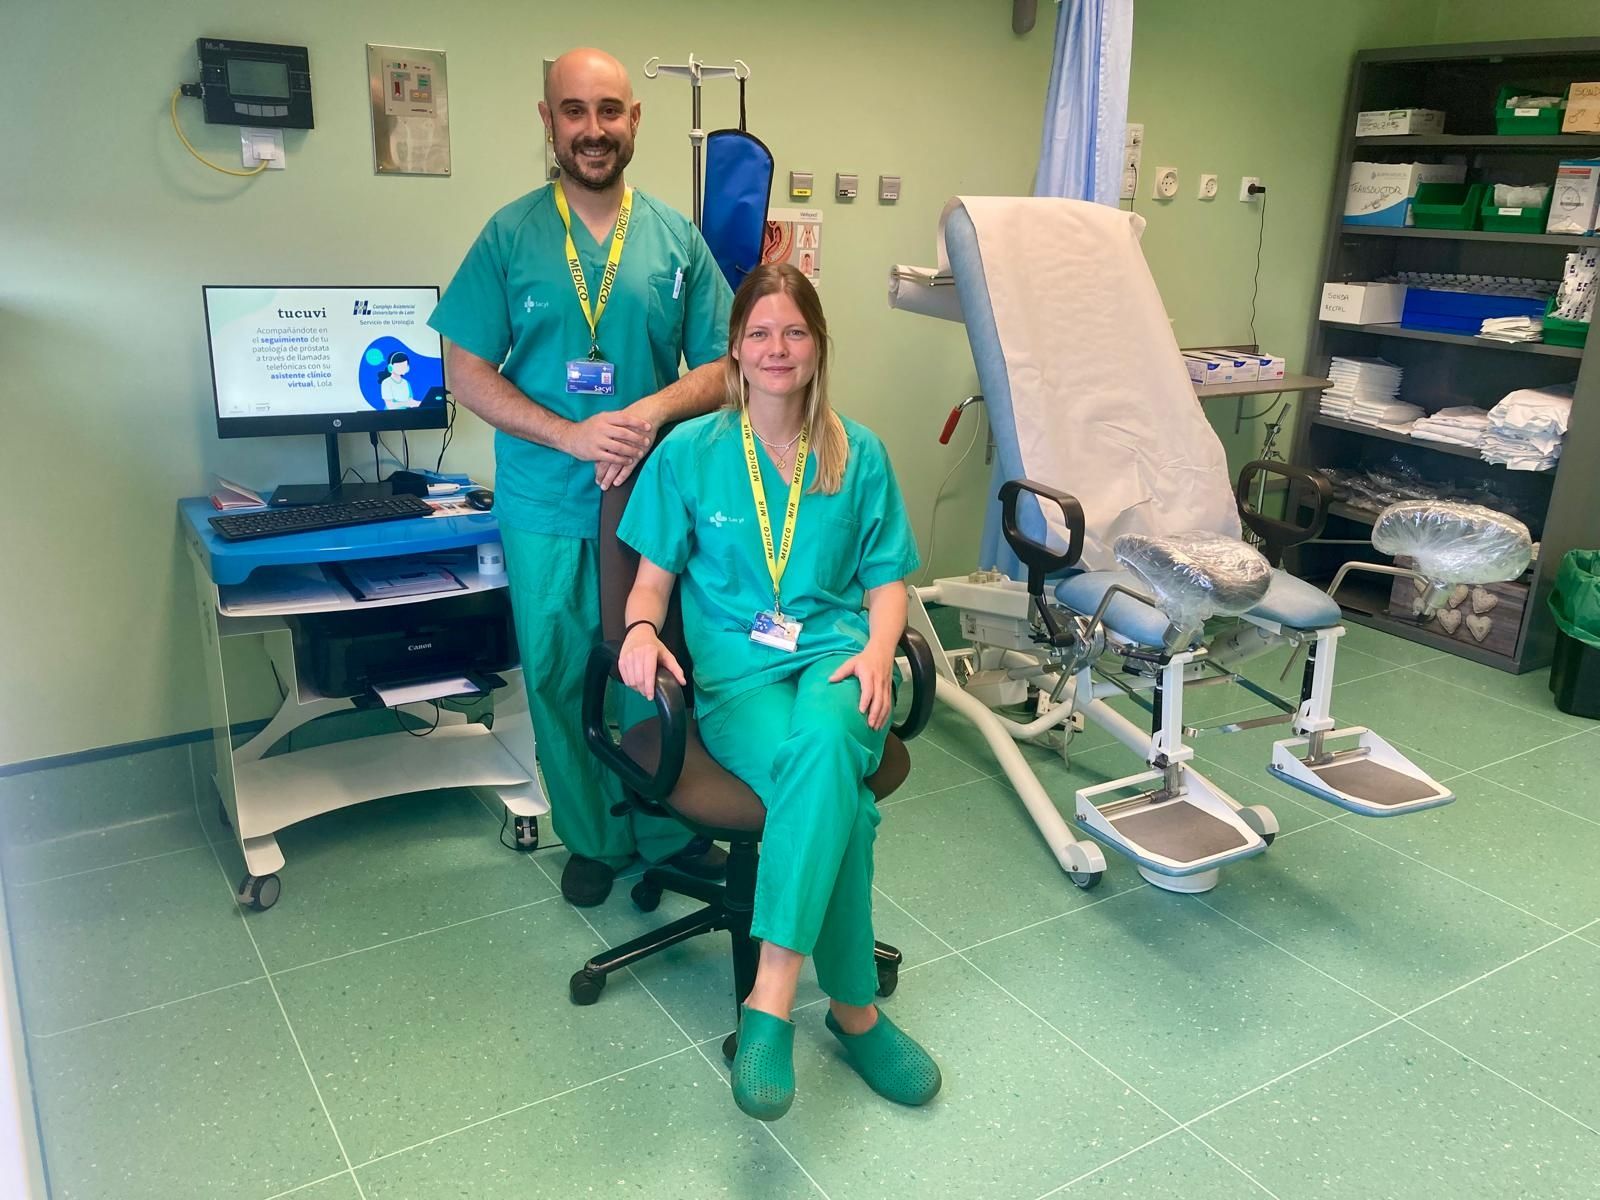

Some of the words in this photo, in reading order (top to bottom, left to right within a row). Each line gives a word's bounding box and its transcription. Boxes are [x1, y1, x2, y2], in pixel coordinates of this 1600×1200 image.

[615, 206, 630, 241] MEDICO
[569, 258, 588, 302] MEDICO
[600, 260, 617, 305] MEDICO
[277, 307, 327, 319] tucuvi
[256, 327, 318, 336] Acompañándote
[260, 336, 309, 345] seguimiento
[252, 345, 288, 354] patología
[288, 344, 299, 352] de
[286, 353, 297, 361] de
[297, 353, 330, 361] llamadas
[271, 371, 306, 379] asistente
[288, 380, 316, 389] virtual,
[317, 380, 333, 388] Lola
[594, 385, 612, 393] Sacyl
[743, 424, 751, 440] MIR
[748, 449, 760, 482] MEDICO
[794, 452, 805, 485] MEDICO
[758, 500, 767, 517] MIR
[780, 527, 792, 561] MEDICO
[788, 502, 796, 519] MIR
[763, 526, 774, 560] MEDICO
[407, 643, 432, 651] Canon
